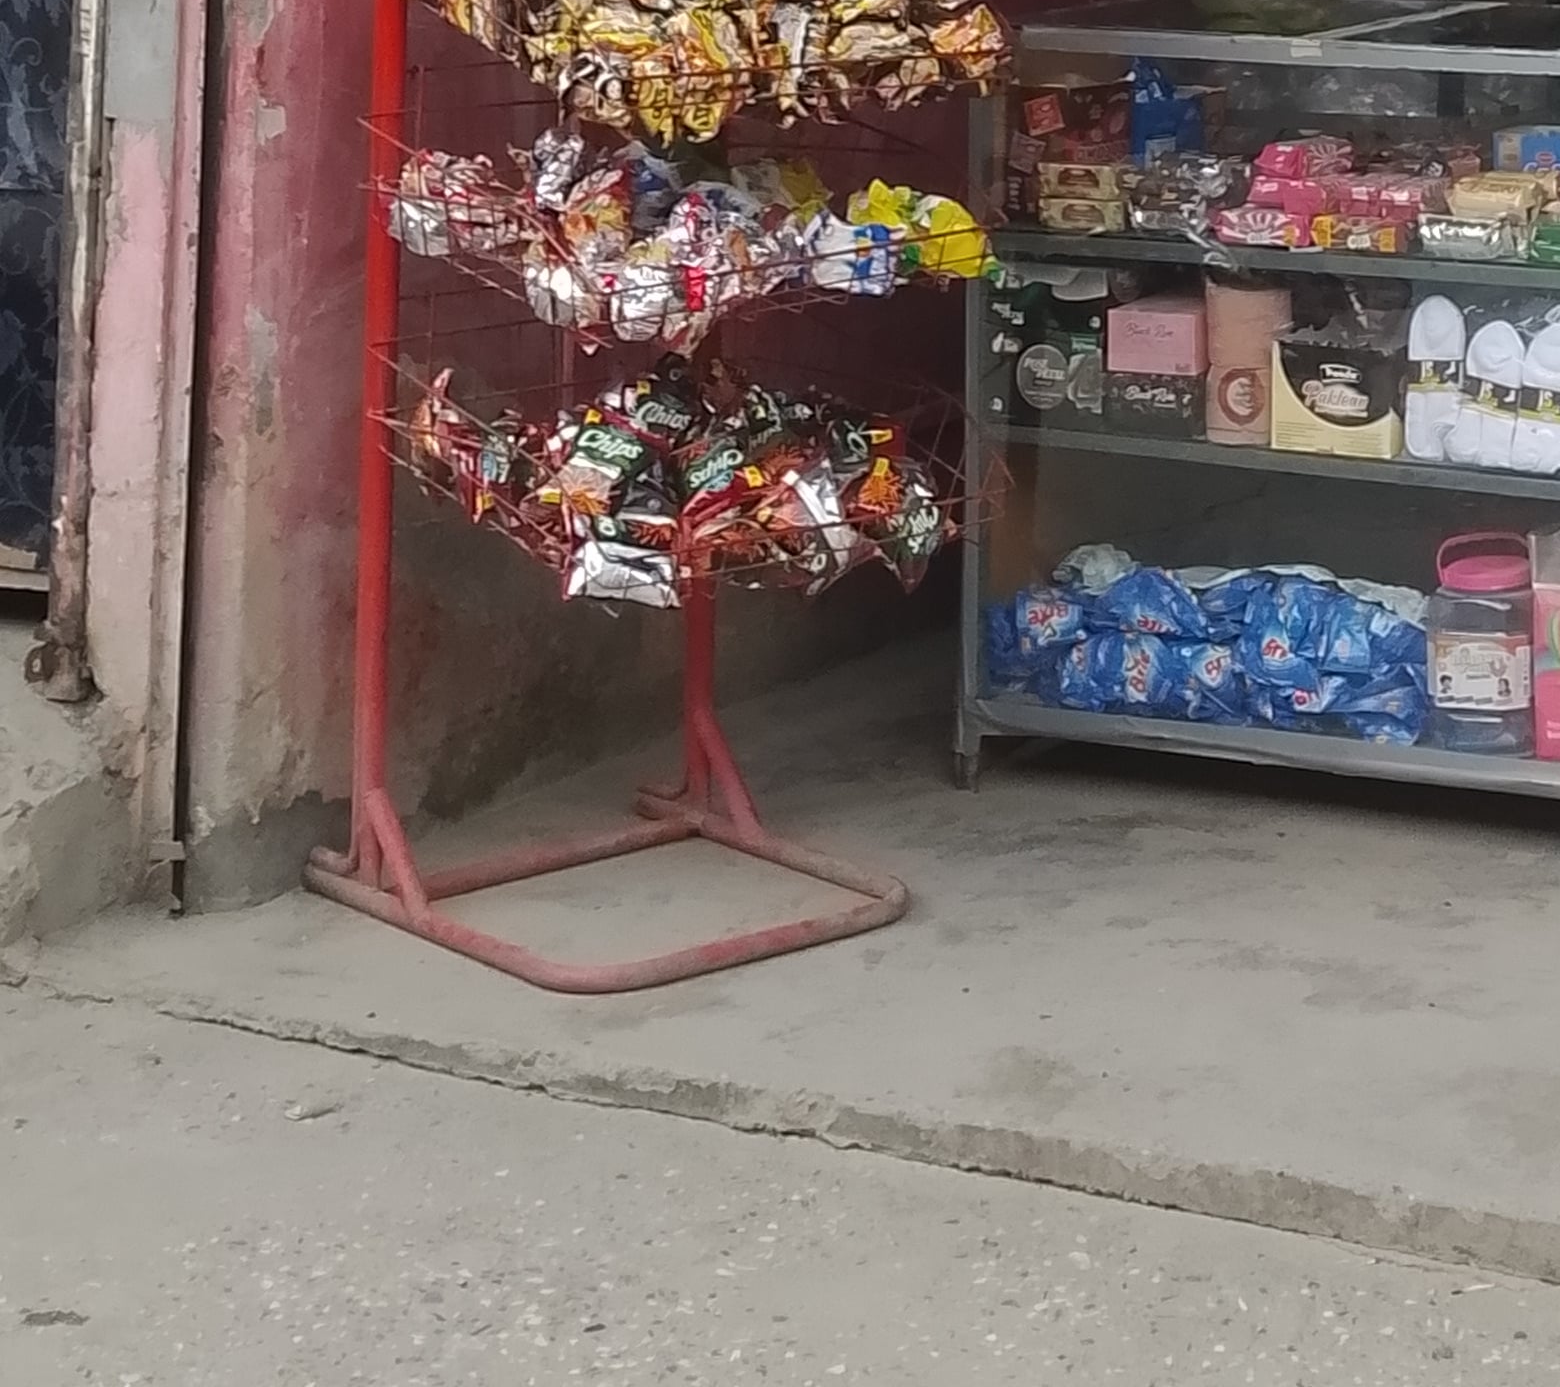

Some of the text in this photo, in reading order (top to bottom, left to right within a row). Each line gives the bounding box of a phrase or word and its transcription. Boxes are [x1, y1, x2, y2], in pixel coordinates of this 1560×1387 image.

[1303, 380, 1369, 409] Paklean
[635, 401, 693, 429] Chips
[577, 428, 644, 460] Chips
